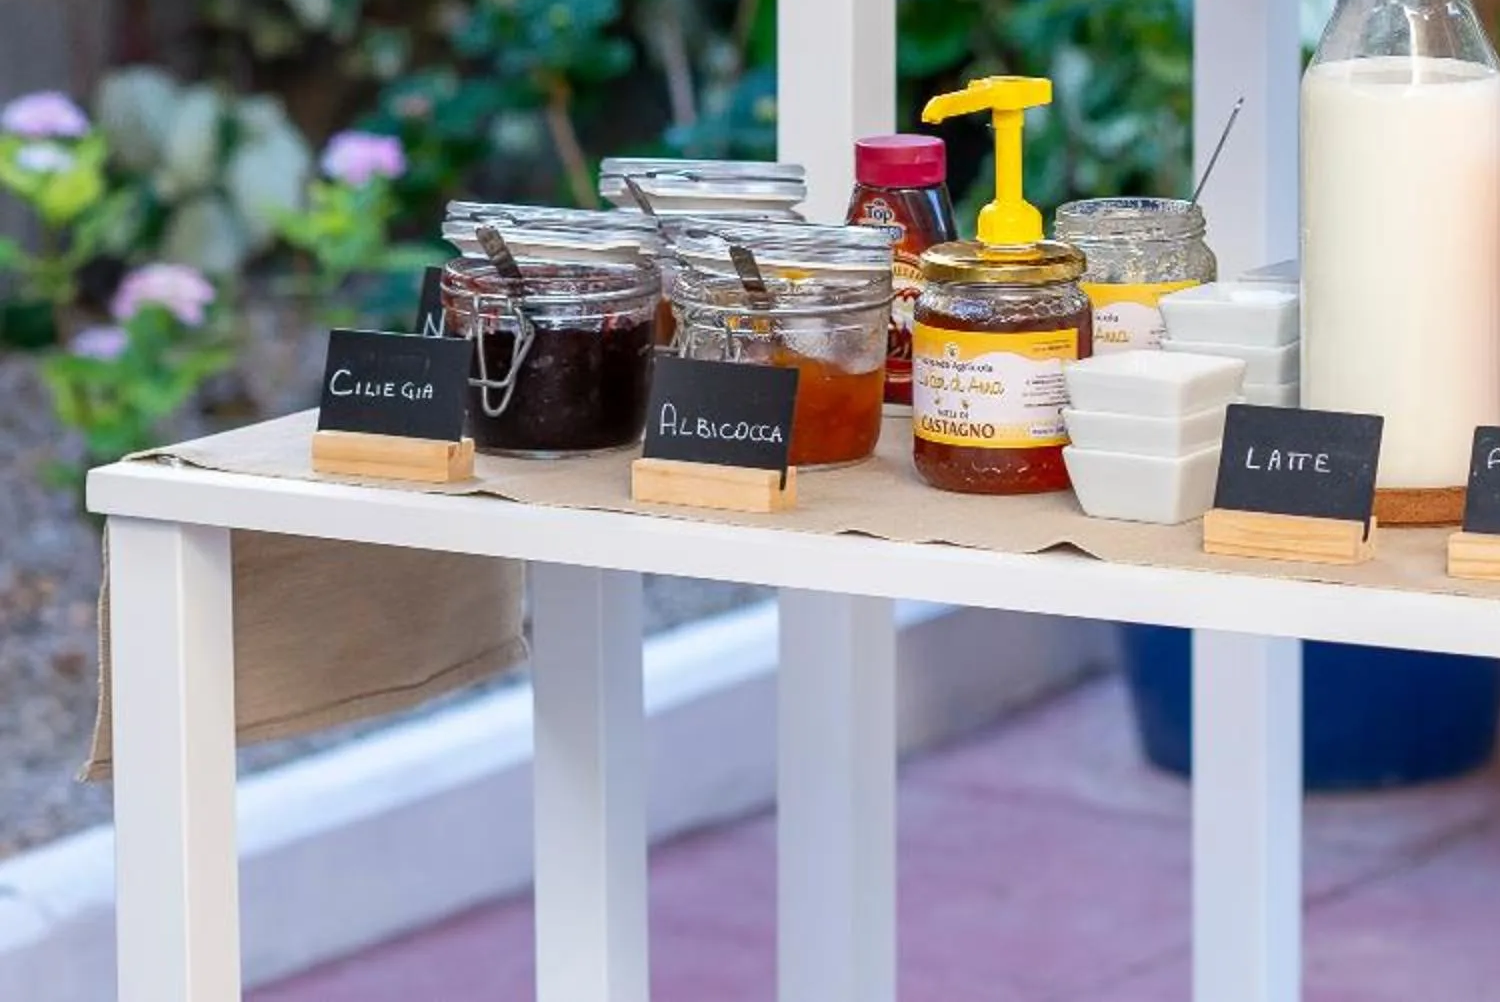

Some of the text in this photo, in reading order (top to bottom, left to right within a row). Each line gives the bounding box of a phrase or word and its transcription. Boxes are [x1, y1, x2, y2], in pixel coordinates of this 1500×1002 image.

[865, 205, 894, 224] Top
[920, 414, 996, 439] CASTAGNO
[1244, 446, 1332, 474] LATTE
